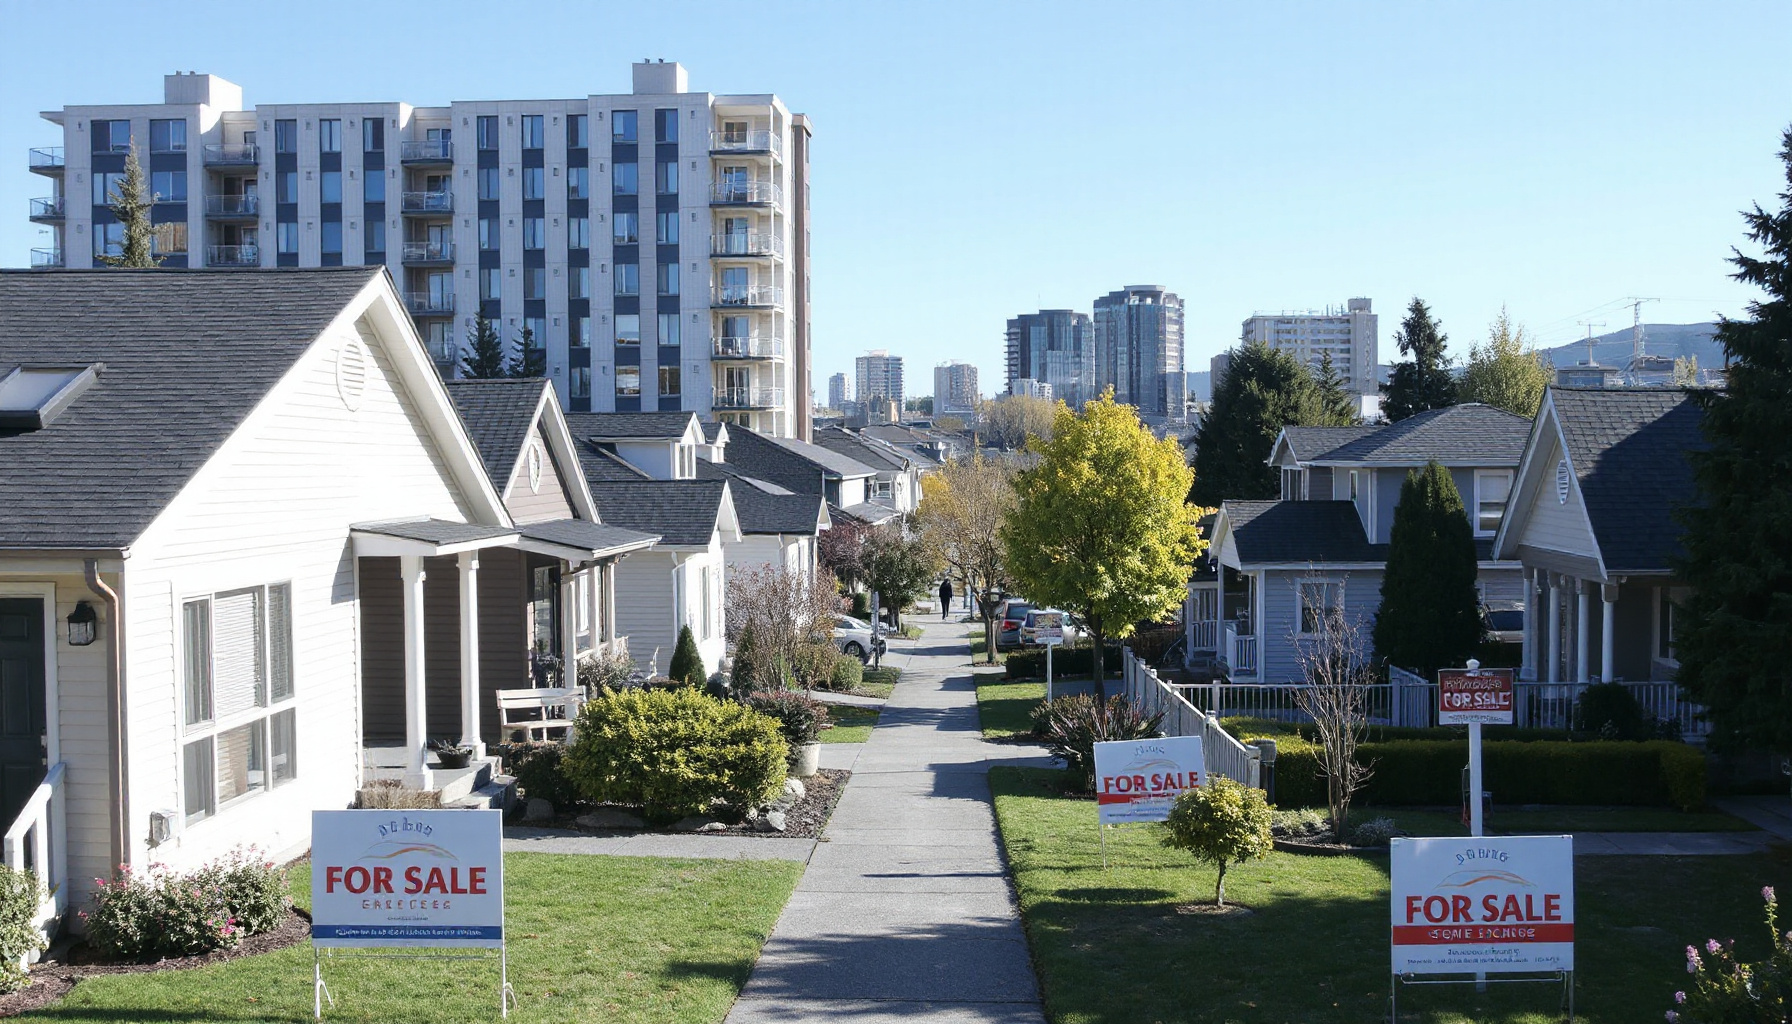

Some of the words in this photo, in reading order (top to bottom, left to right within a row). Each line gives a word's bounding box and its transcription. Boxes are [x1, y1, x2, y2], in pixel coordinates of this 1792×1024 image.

[1103, 774, 1148, 794] FOR
[1150, 771, 1200, 792] SALE
[326, 866, 394, 894] FOR
[404, 866, 487, 894] SALE
[1406, 895, 1474, 923] FOR
[1482, 894, 1562, 922] SALE
